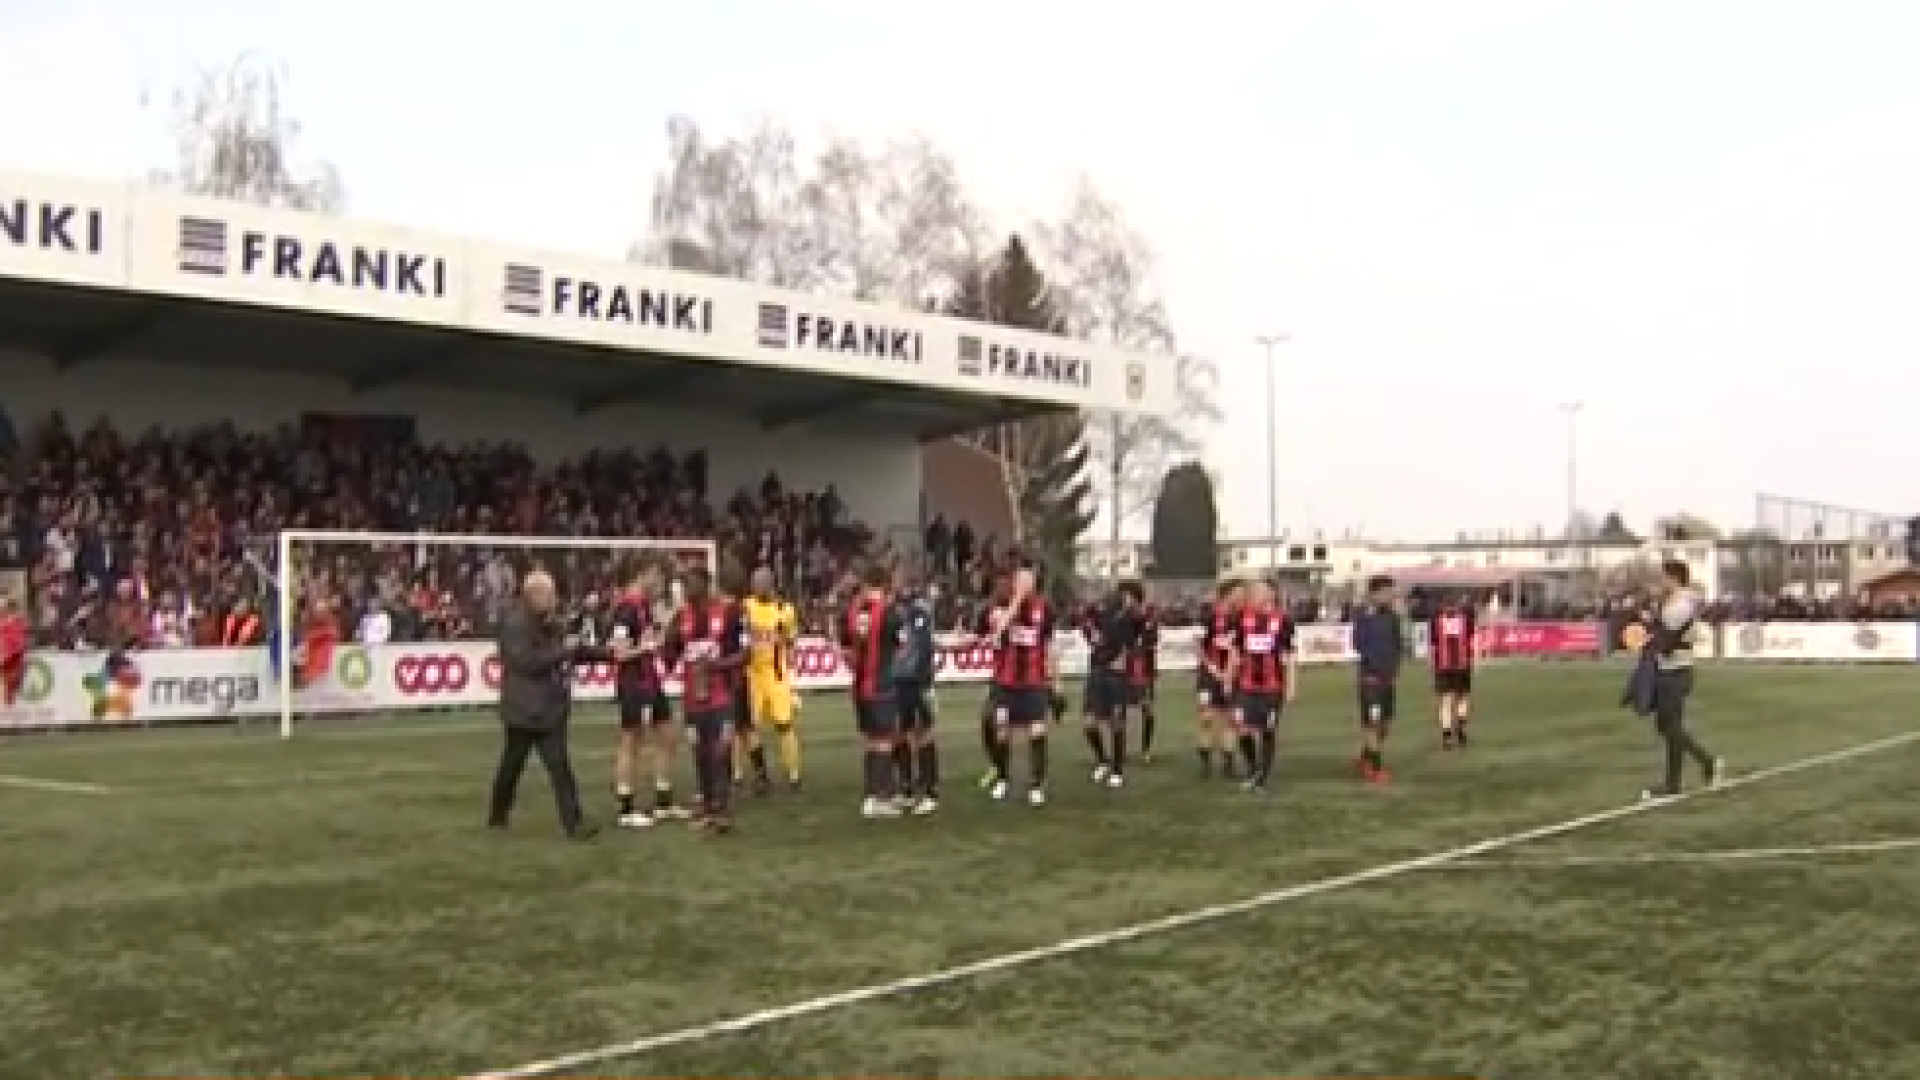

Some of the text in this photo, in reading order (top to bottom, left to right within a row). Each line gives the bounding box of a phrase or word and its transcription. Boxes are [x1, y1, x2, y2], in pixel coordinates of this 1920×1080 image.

[241, 231, 446, 298] FRANKI
[552, 277, 713, 334] FRANKI
[796, 312, 924, 364] FRANKI
[988, 344, 1091, 387] FRANKI
[150, 675, 260, 716] mega
